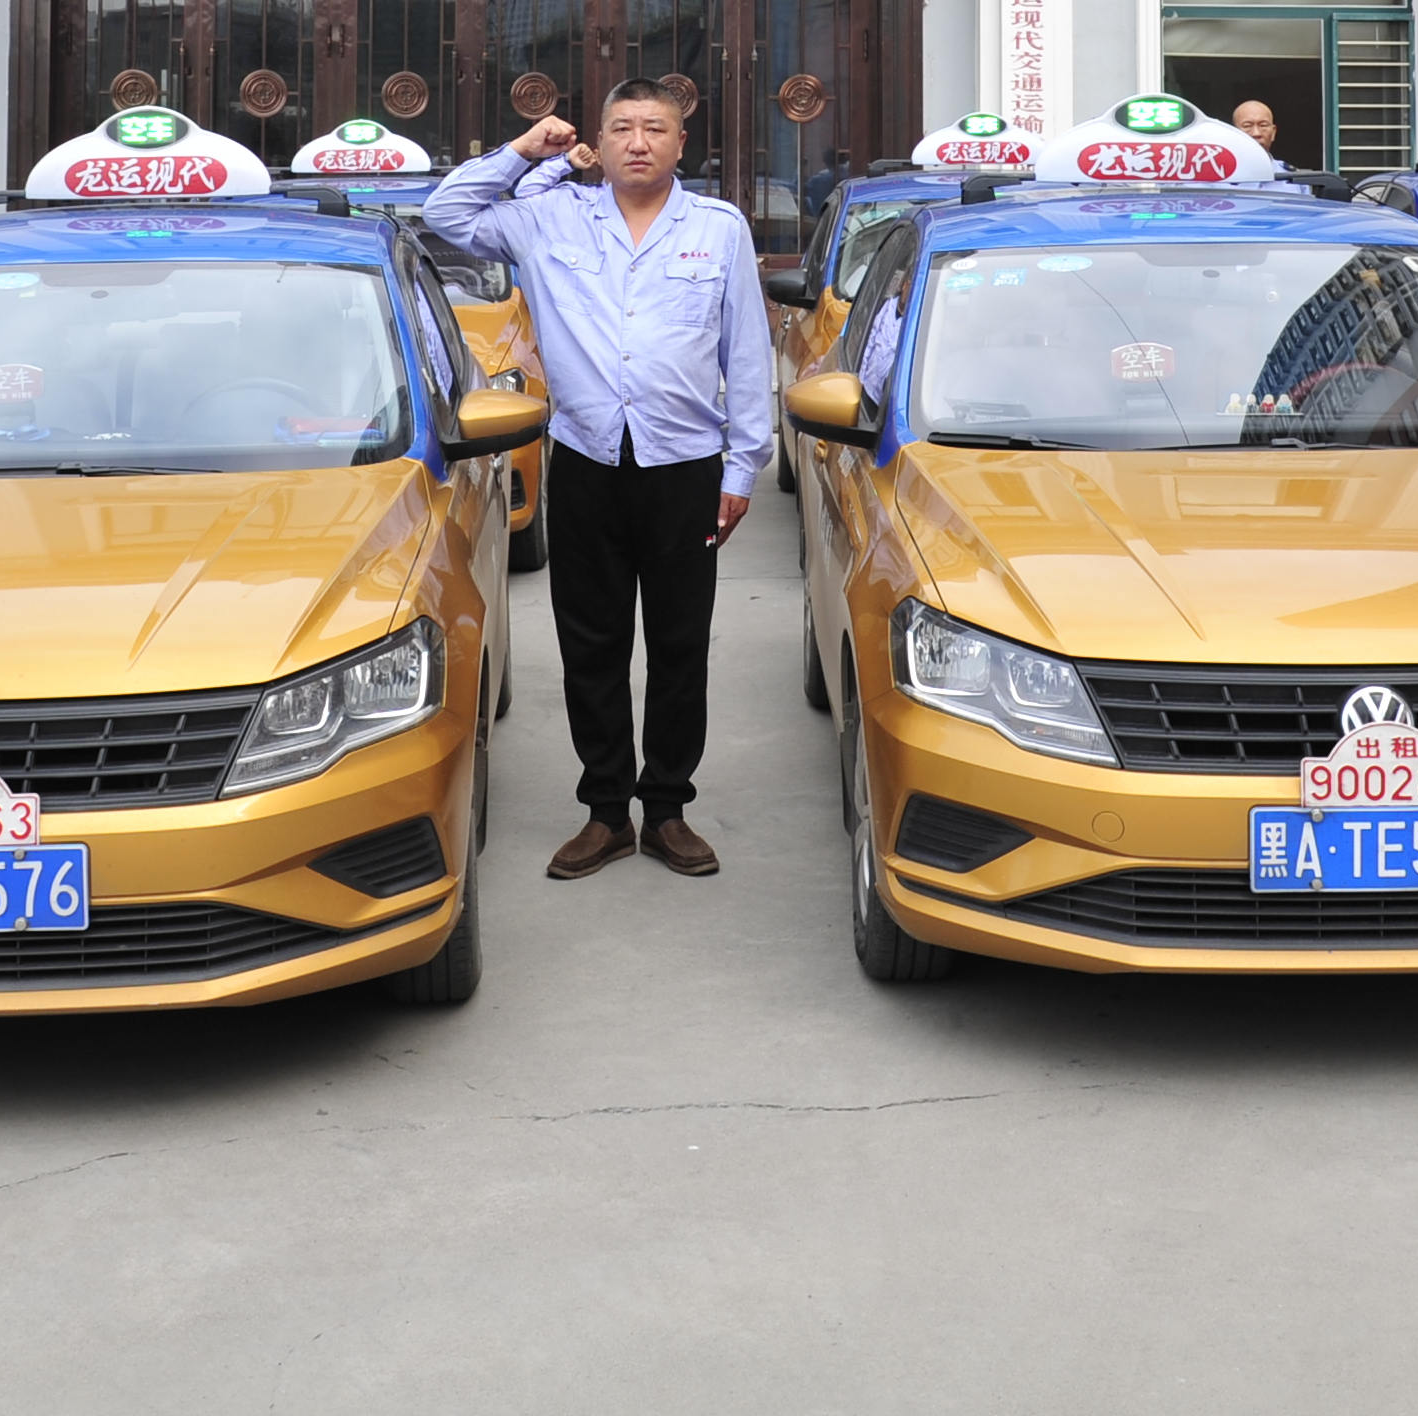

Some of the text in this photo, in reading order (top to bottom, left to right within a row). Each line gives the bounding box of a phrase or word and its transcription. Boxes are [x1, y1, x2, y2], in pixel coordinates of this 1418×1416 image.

[1128, 101, 1180, 127] 空车
[121, 116, 173, 142] 空车
[318, 149, 398, 171] 龙运现代
[941, 141, 1024, 164] 龙运现代
[1087, 144, 1227, 181] 龙运现代
[74, 157, 216, 193] 龙运现代
[1121, 346, 1166, 370] 空车
[1122, 369, 1164, 379] FOR HIRE
[11, 391, 32, 400] HIRE
[1356, 736, 1418, 759] 出租
